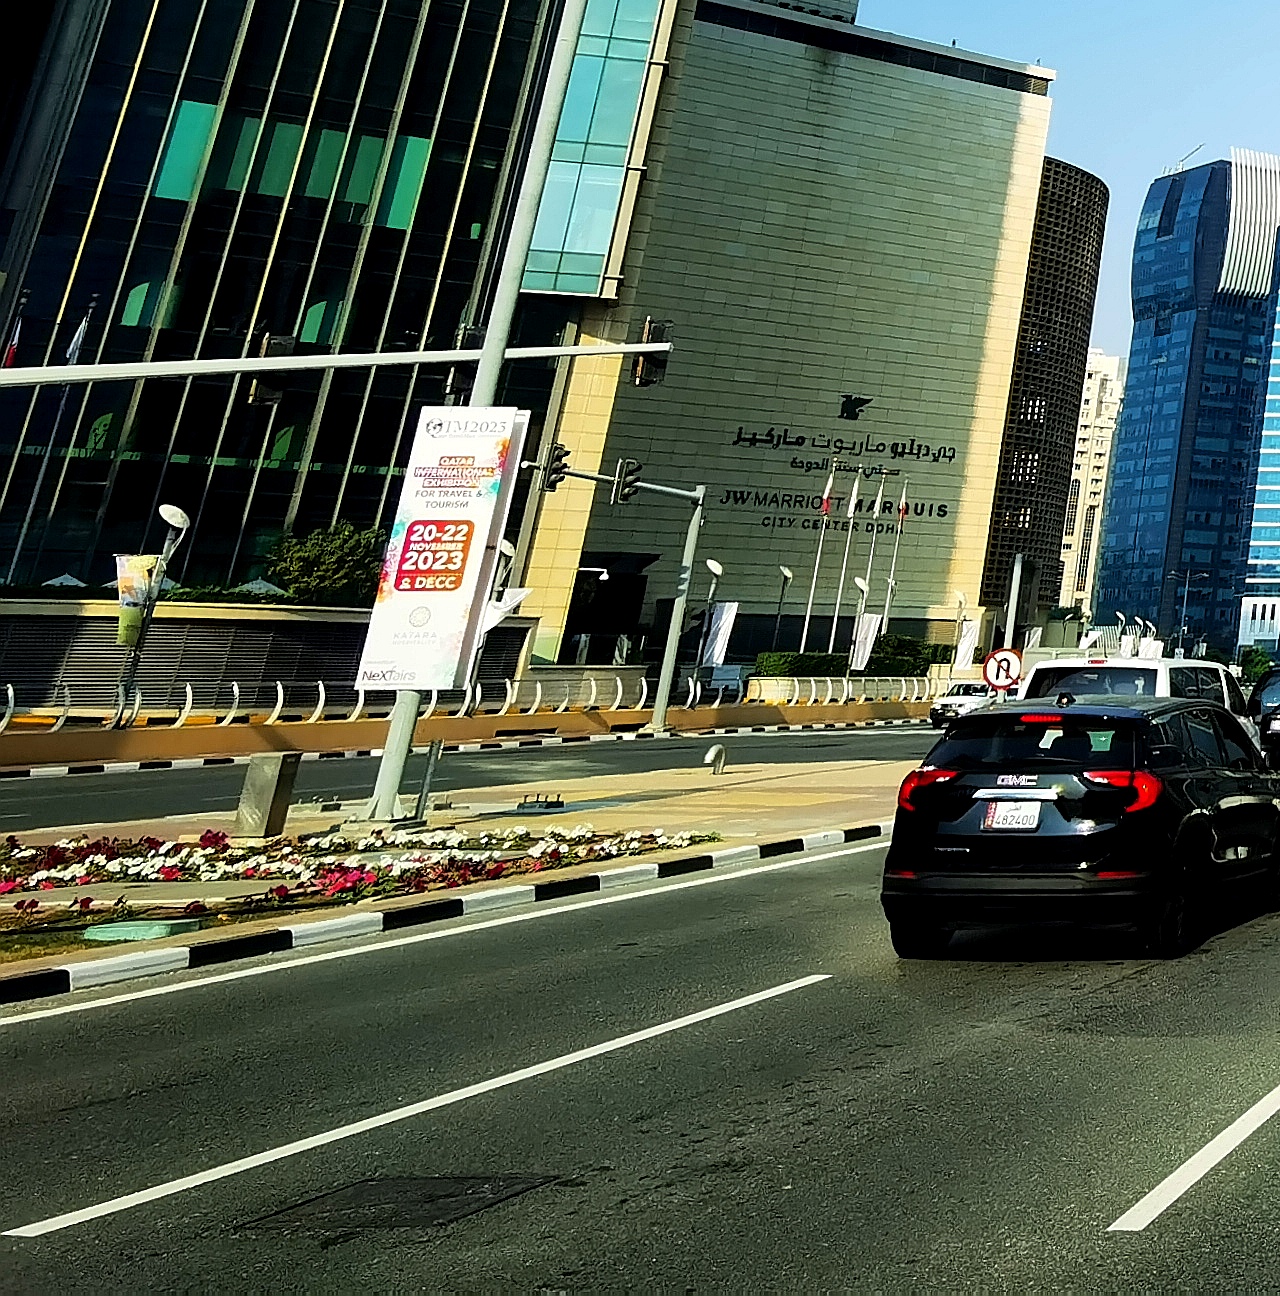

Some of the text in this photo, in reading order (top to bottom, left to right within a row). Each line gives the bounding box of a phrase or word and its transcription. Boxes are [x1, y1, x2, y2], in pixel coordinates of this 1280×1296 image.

[811, 433, 887, 457] ماريوت
[440, 456, 475, 466] QATAR
[789, 456, 830, 474] الدوحة
[415, 490, 435, 498] FOR
[440, 490, 473, 498] TRAVEL
[761, 516, 796, 528] CITY
[801, 518, 860, 532] CENTER
[410, 524, 469, 542] 20-22
[401, 551, 464, 571] 2023
[414, 576, 457, 589] DECC
[997, 774, 1038, 786] GMC
[995, 814, 1036, 826] 482400
